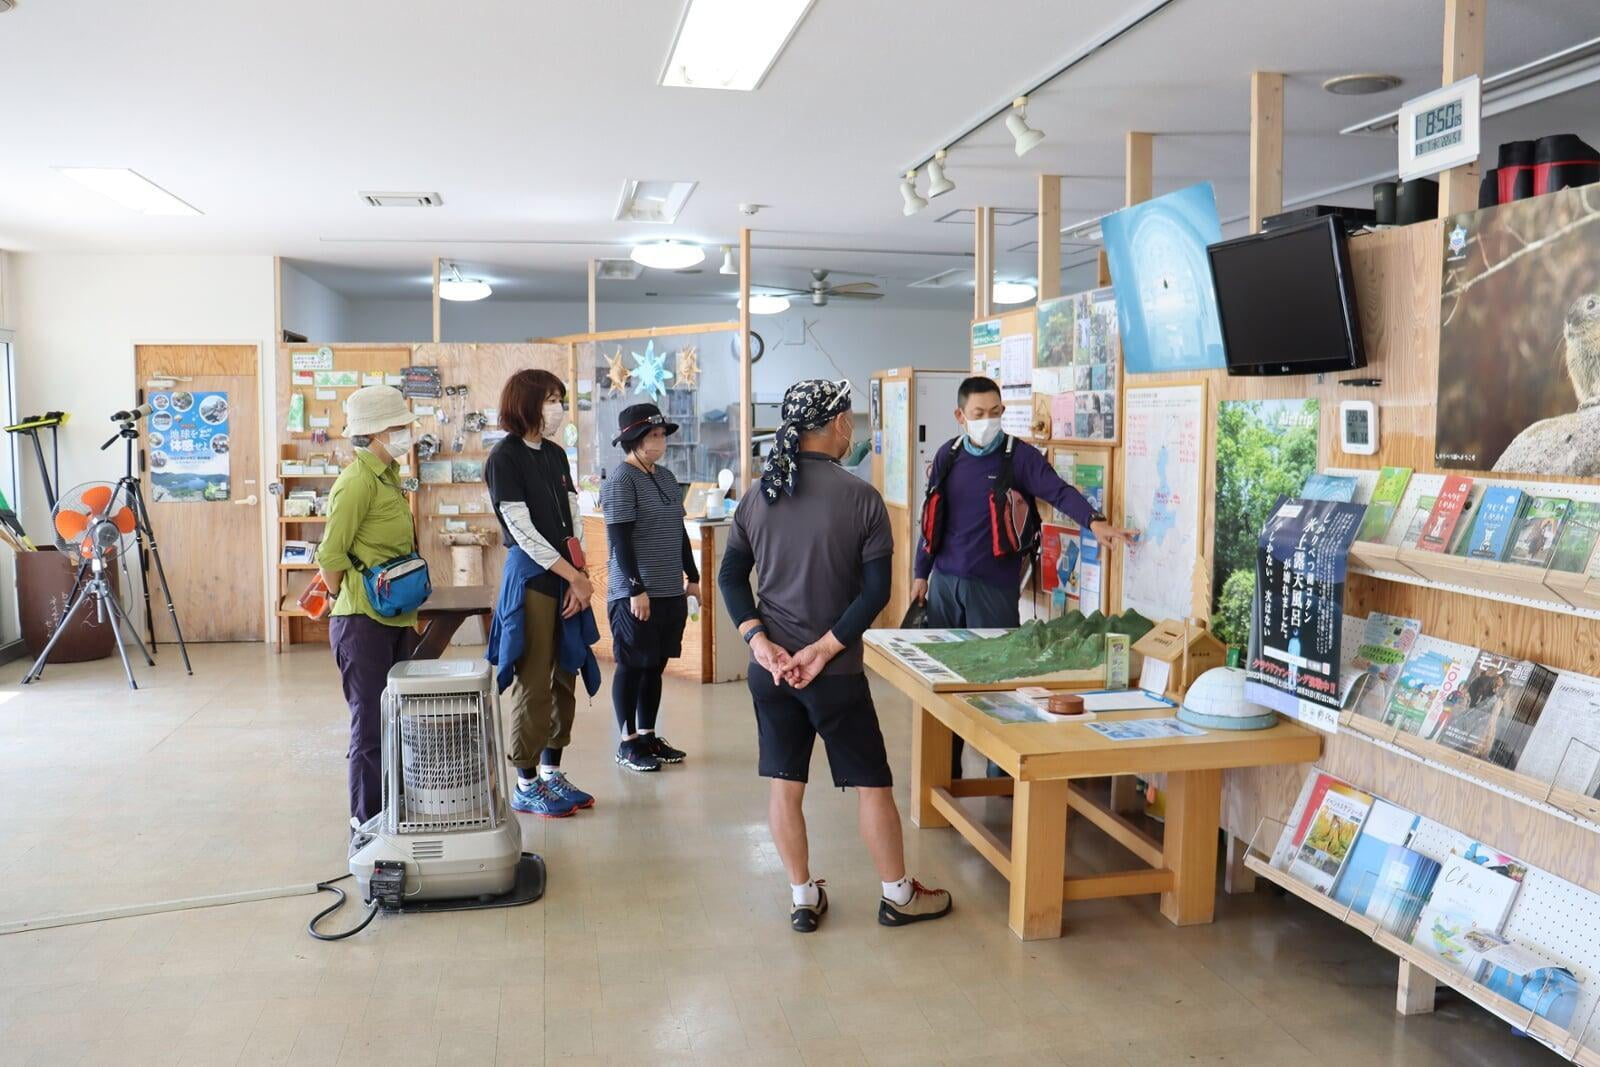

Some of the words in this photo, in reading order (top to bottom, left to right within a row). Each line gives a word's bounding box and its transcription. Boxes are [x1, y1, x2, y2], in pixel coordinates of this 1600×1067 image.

[1291, 517, 1318, 628] 氷上露天風呂
[1303, 512, 1331, 624] しかりべつ湖コタン
